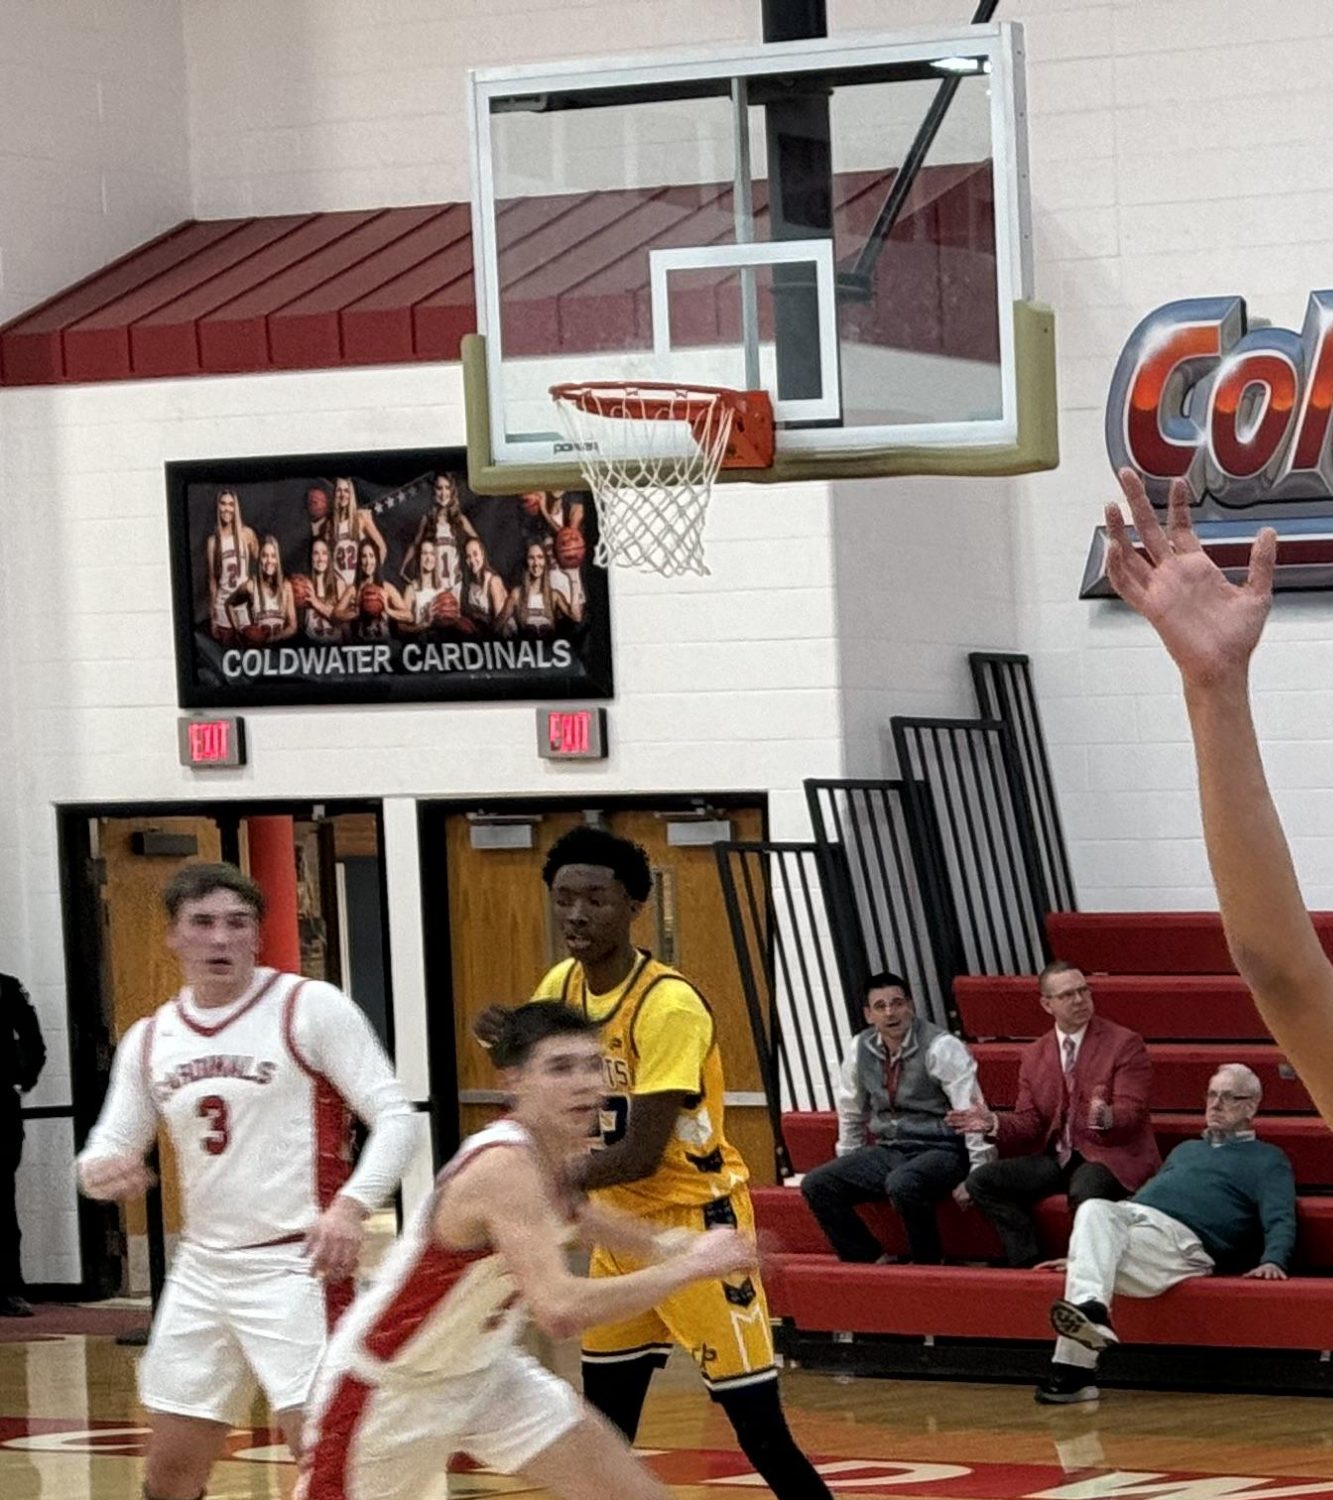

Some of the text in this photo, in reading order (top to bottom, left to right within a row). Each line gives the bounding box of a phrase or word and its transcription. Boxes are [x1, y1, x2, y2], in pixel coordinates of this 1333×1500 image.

[222, 640, 572, 678] COLDWATER CARDINALS
[188, 721, 229, 762] EXIT
[196, 1094, 231, 1155] 3
